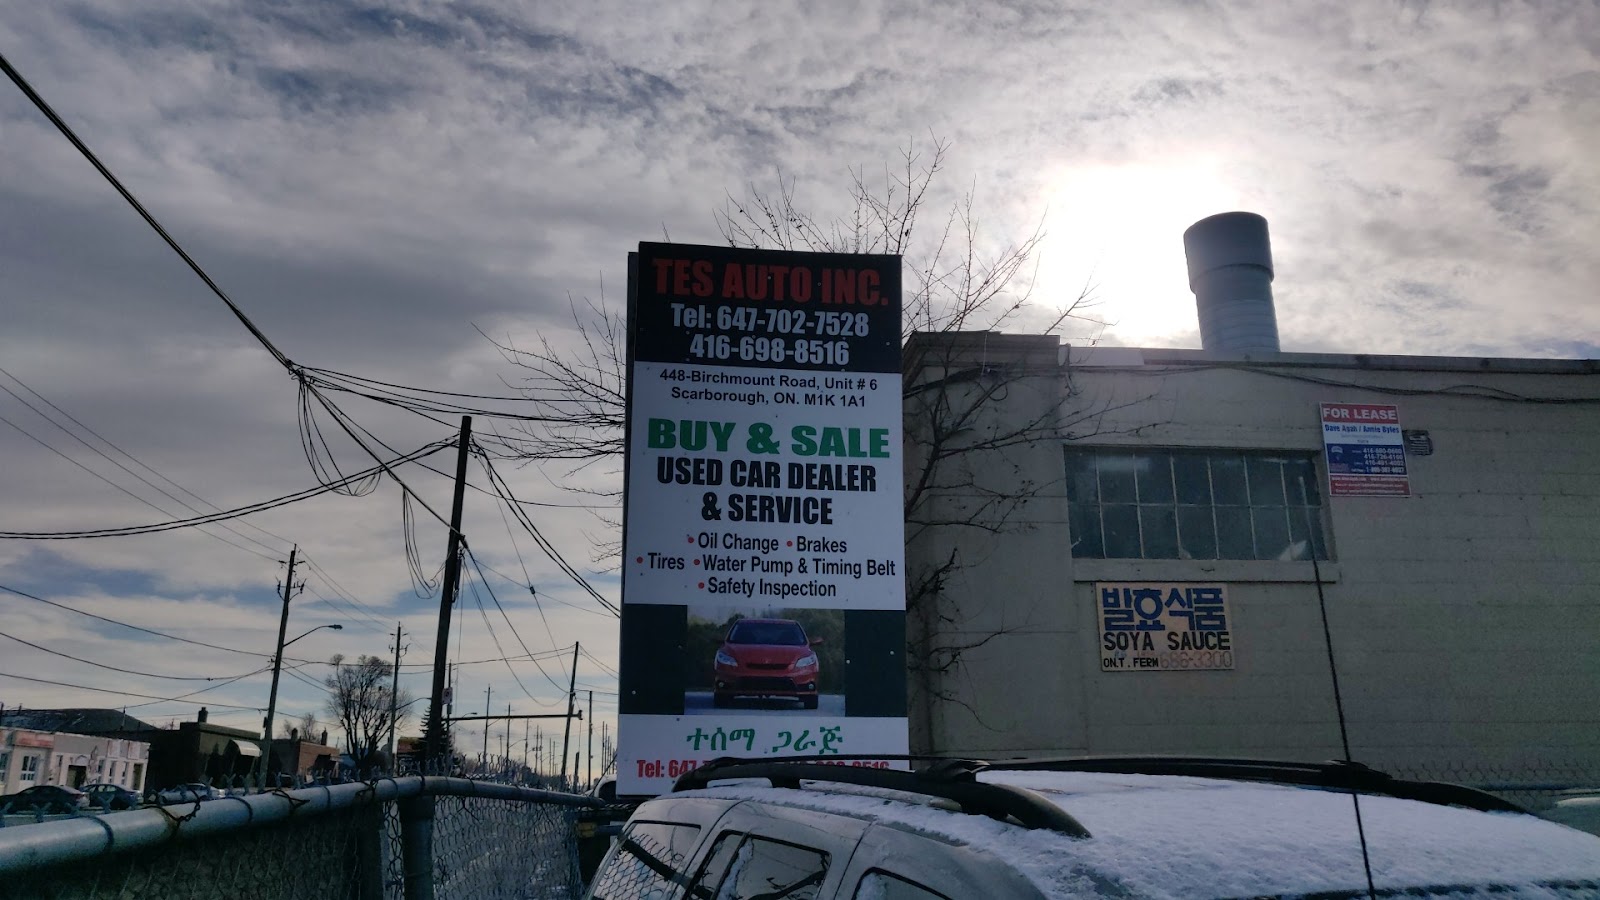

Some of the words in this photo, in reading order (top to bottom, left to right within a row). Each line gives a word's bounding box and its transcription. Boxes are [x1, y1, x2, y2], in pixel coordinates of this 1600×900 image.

[653, 258, 714, 297] TES
[722, 263, 812, 302] AUTO
[821, 268, 888, 306] INC.
[671, 303, 712, 329] Tel:
[717, 306, 869, 337] 647-702-7528
[690, 334, 849, 365] 416-698-8516
[660, 369, 775, 387] 448-Birchmount
[779, 374, 820, 390] Road,
[825, 376, 853, 390] Unit
[857, 378, 866, 390] #
[869, 379, 878, 391] 6
[671, 386, 769, 406] Scarborough,
[774, 392, 800, 405] ON.
[804, 393, 836, 407] M1K
[841, 394, 866, 407] 1A1
[1324, 408, 1349, 419] FOR
[1354, 409, 1397, 420] LEASE
[647, 417, 736, 452] BUY
[746, 422, 780, 454] &
[791, 425, 890, 458] SALE
[657, 456, 723, 486] USED
[730, 459, 781, 489] CAR
[788, 462, 877, 492] DEALER
[701, 491, 722, 521] &
[728, 493, 833, 525] SERVICE
[698, 532, 718, 550] Oil
[723, 533, 779, 554] Change
[796, 536, 847, 553] Brakes
[647, 552, 685, 570] Tires
[703, 555, 746, 572] Water
[751, 556, 793, 577] Pump
[798, 559, 808, 574] &
[812, 558, 862, 579] Timing
[867, 559, 896, 576] Belt
[708, 576, 755, 598] Safety
[759, 579, 837, 598] Inspection
[1102, 587, 1227, 631] 발효식품
[1103, 631, 1155, 651] SOYA
[1167, 631, 1231, 651] SAUCE
[1133, 657, 1159, 668] FERM
[686, 726, 756, 751] ተሰማ
[636, 759, 665, 778] Tel:
